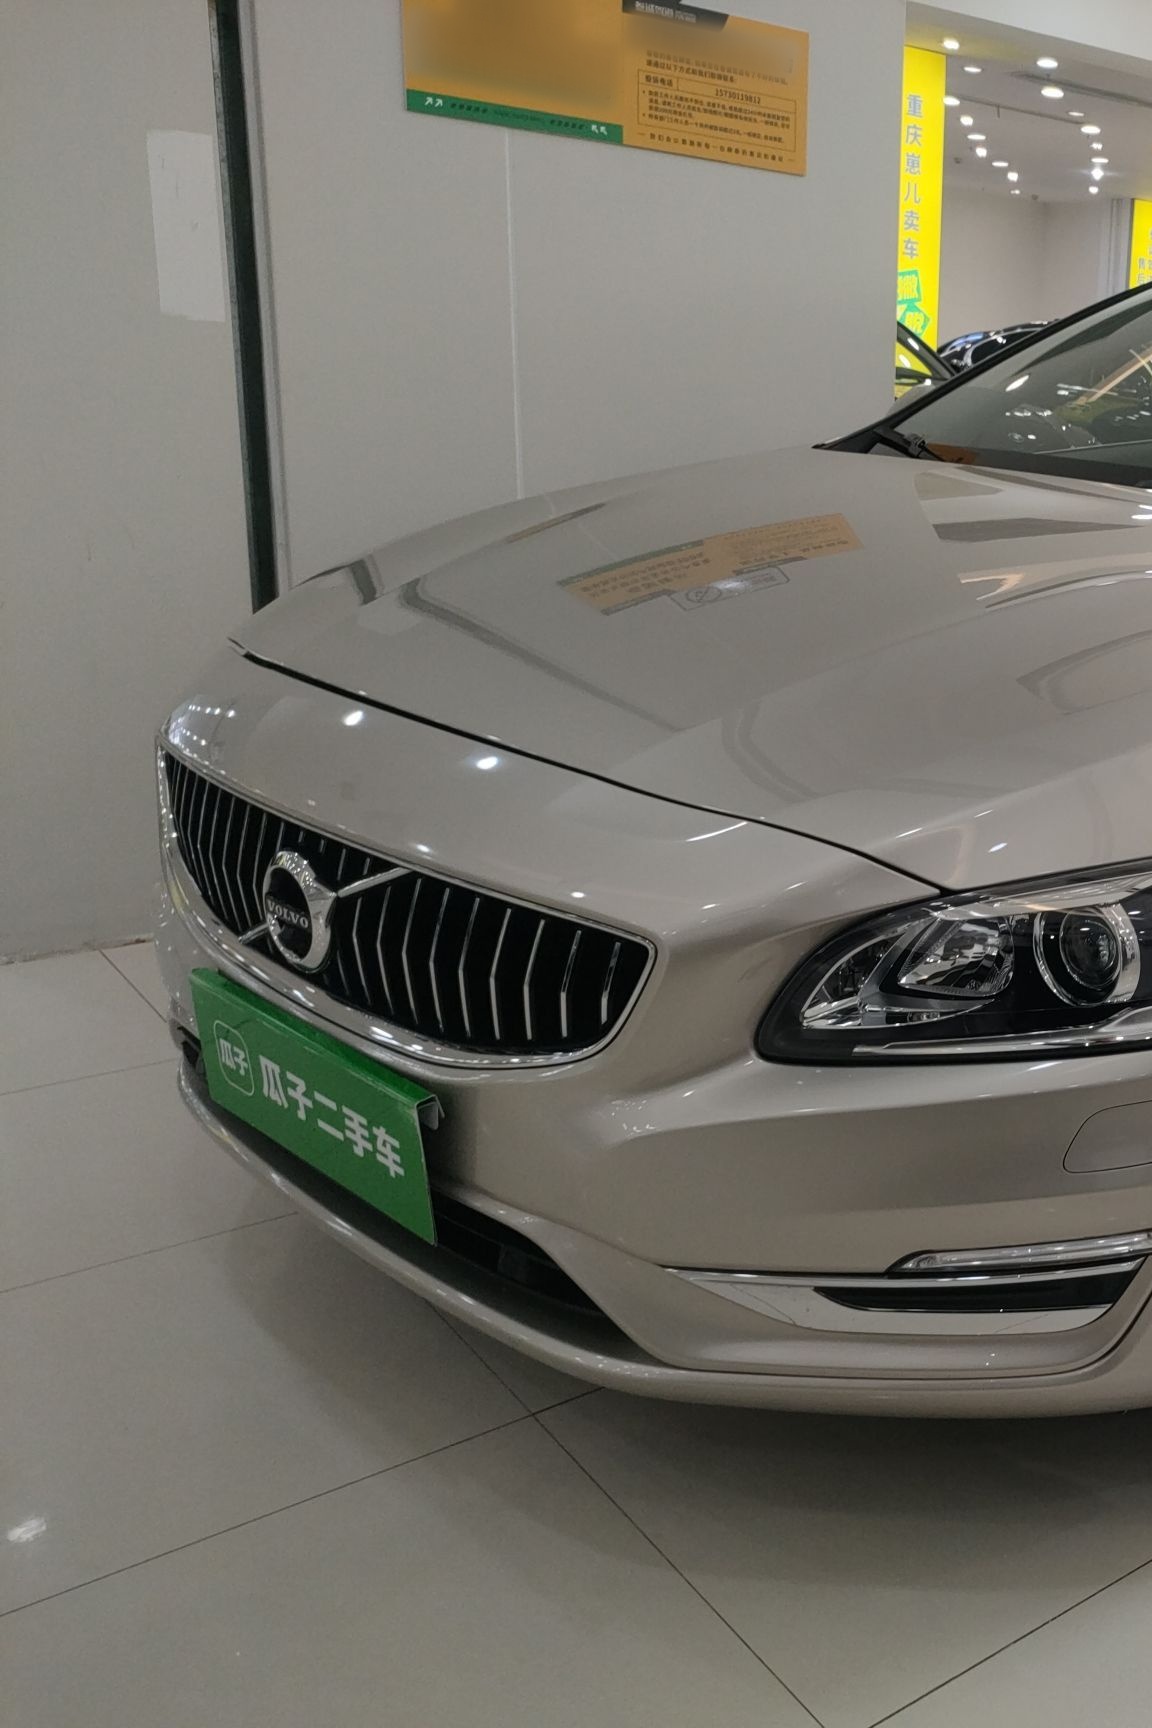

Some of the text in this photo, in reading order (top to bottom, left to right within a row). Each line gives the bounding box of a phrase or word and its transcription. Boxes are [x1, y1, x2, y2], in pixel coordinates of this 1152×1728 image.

[903, 94, 922, 260] 重庆崽儿卖车
[265, 898, 310, 929] VOLVO
[217, 1037, 250, 1077] 瓜子
[257, 1053, 406, 1180] 瓜子二手车
